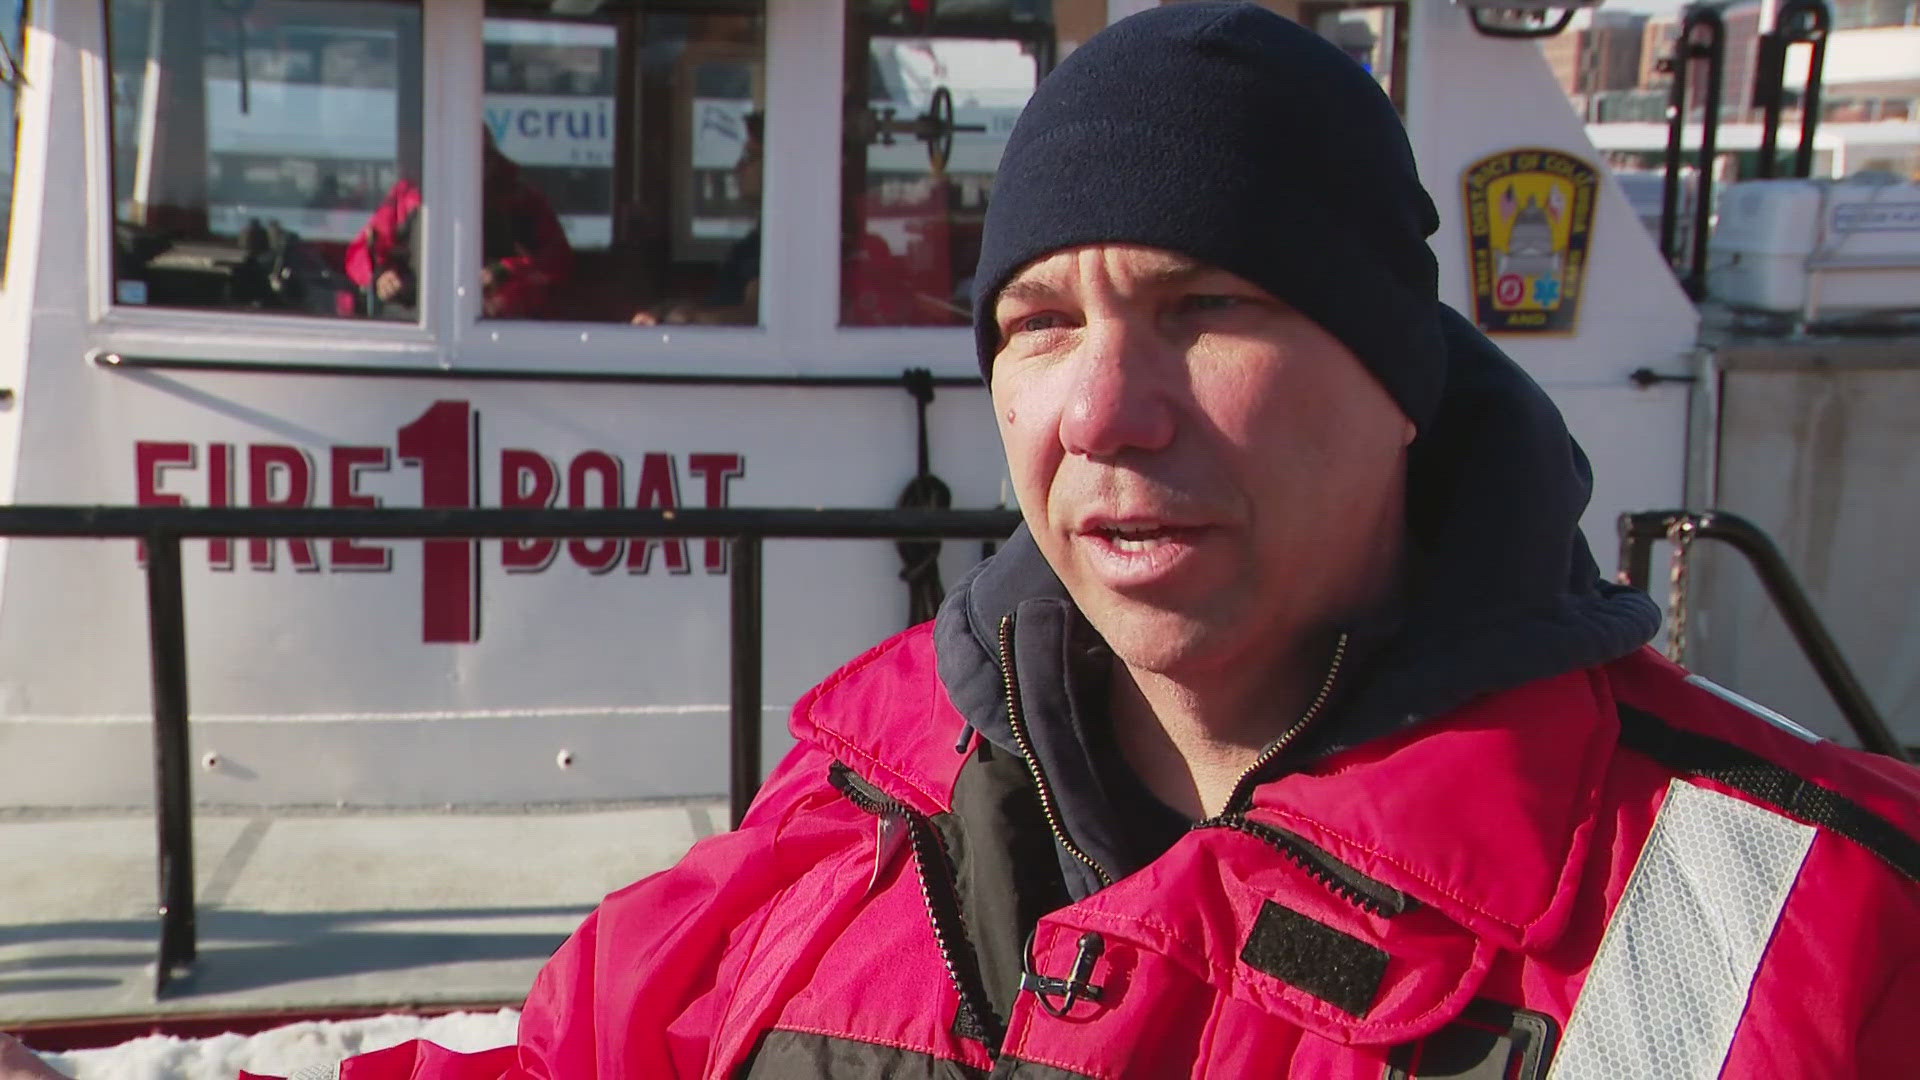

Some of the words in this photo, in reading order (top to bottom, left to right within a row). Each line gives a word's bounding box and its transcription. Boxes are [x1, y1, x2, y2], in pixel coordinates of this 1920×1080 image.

[1517, 155, 1541, 172] OF
[1506, 312, 1547, 326] AND
[134, 440, 392, 573] FIRE
[397, 399, 481, 643] 1
[500, 448, 745, 575] BOAT
